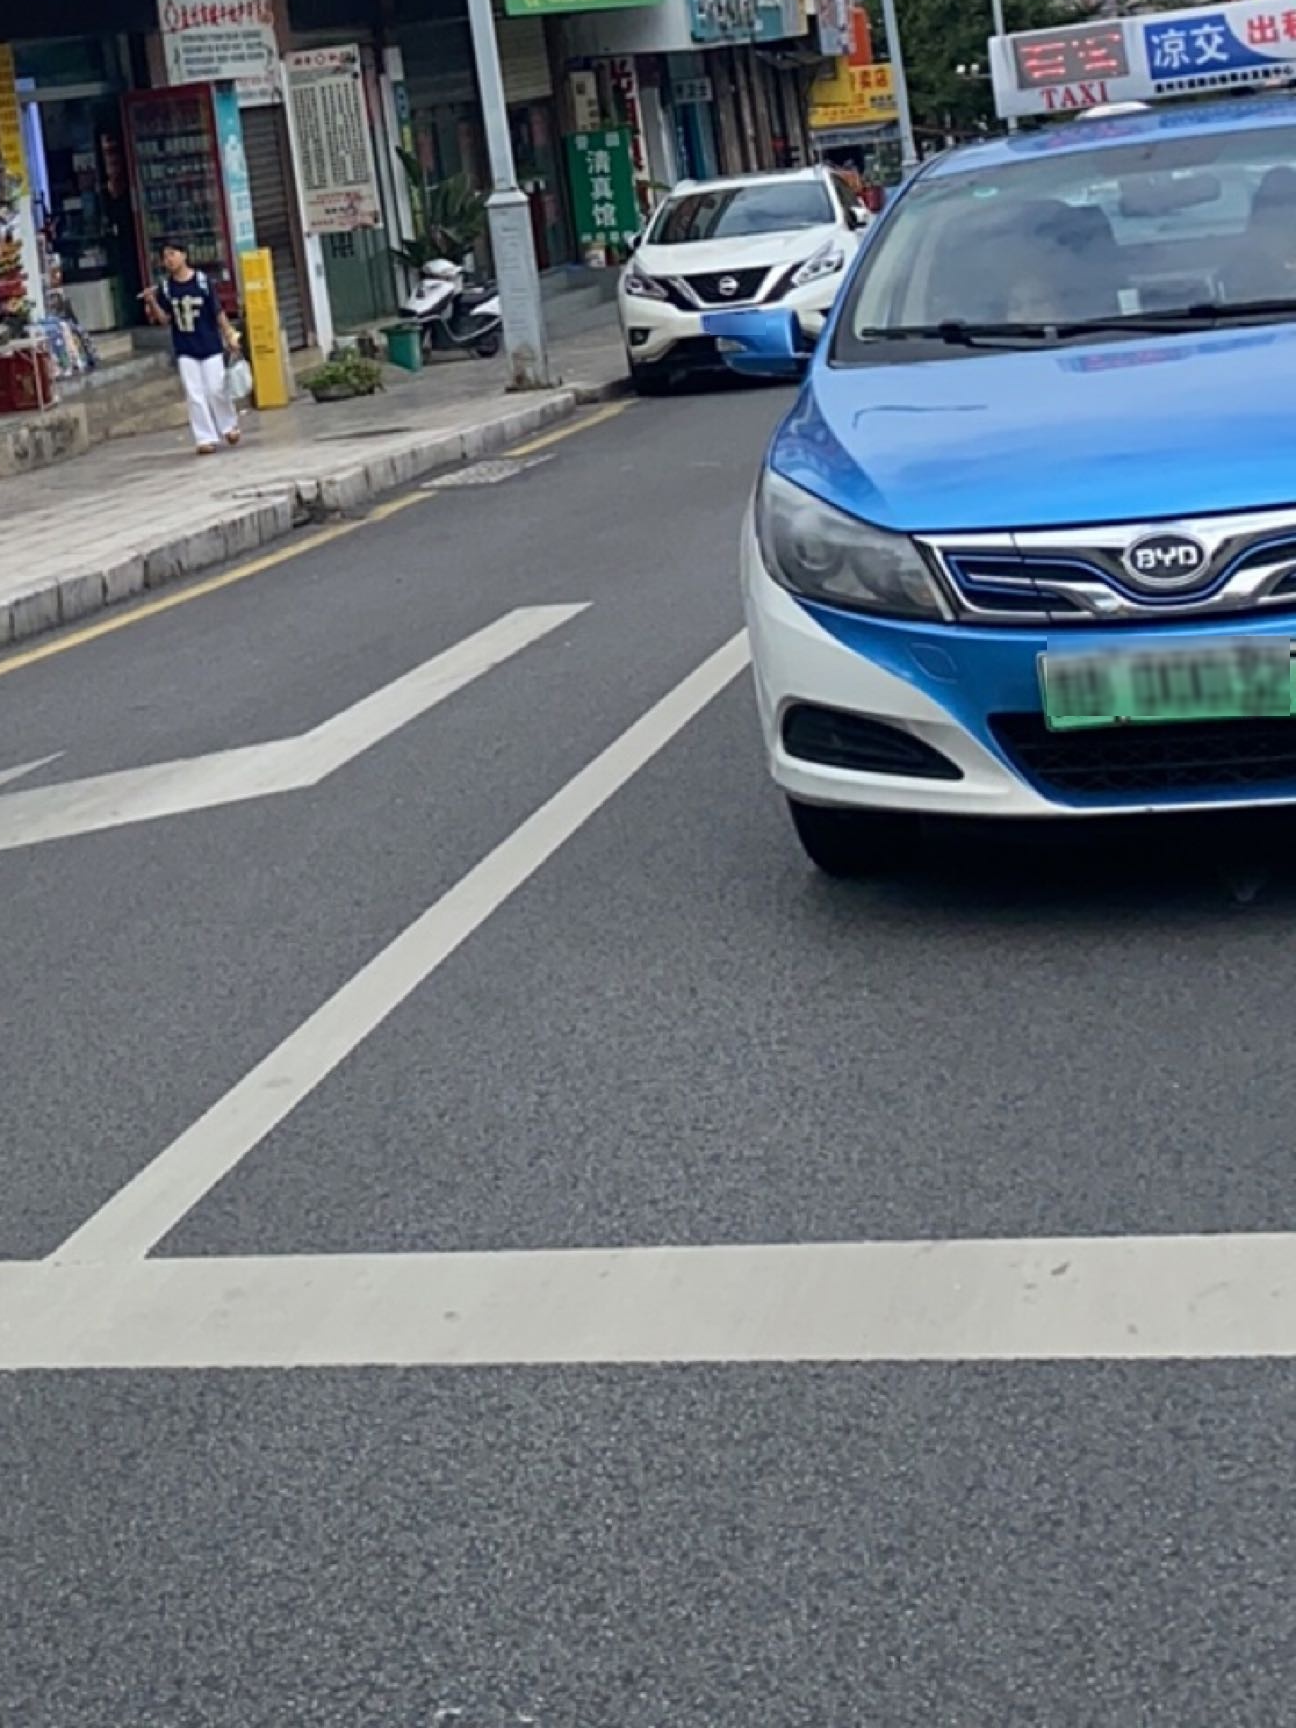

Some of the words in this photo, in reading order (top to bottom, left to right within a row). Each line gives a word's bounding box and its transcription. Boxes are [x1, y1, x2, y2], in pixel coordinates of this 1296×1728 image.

[1152, 24, 1229, 68] 凉交
[1040, 80, 1109, 110] TAXI
[1136, 545, 1198, 569] BYD
